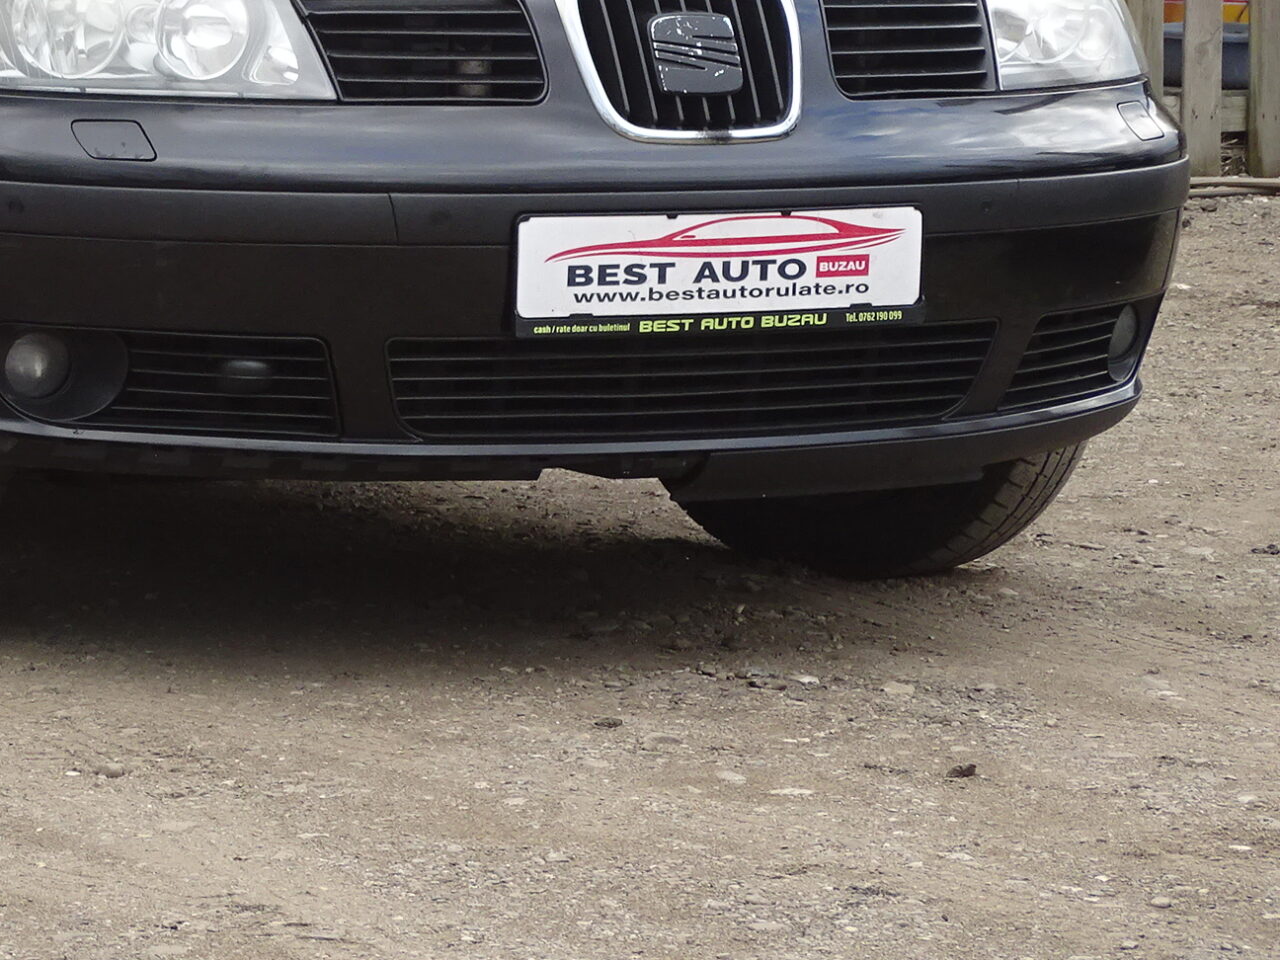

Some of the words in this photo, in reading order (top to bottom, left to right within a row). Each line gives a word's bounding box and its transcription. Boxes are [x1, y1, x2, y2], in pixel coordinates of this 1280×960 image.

[566, 262, 676, 287] BEST
[692, 258, 807, 285] AUTO
[819, 260, 867, 272] BUZAU
[573, 281, 870, 303] www.bestautorulate.ro
[639, 319, 694, 333] BEST
[700, 317, 754, 330] AUTO
[761, 313, 828, 328] BUZAU
